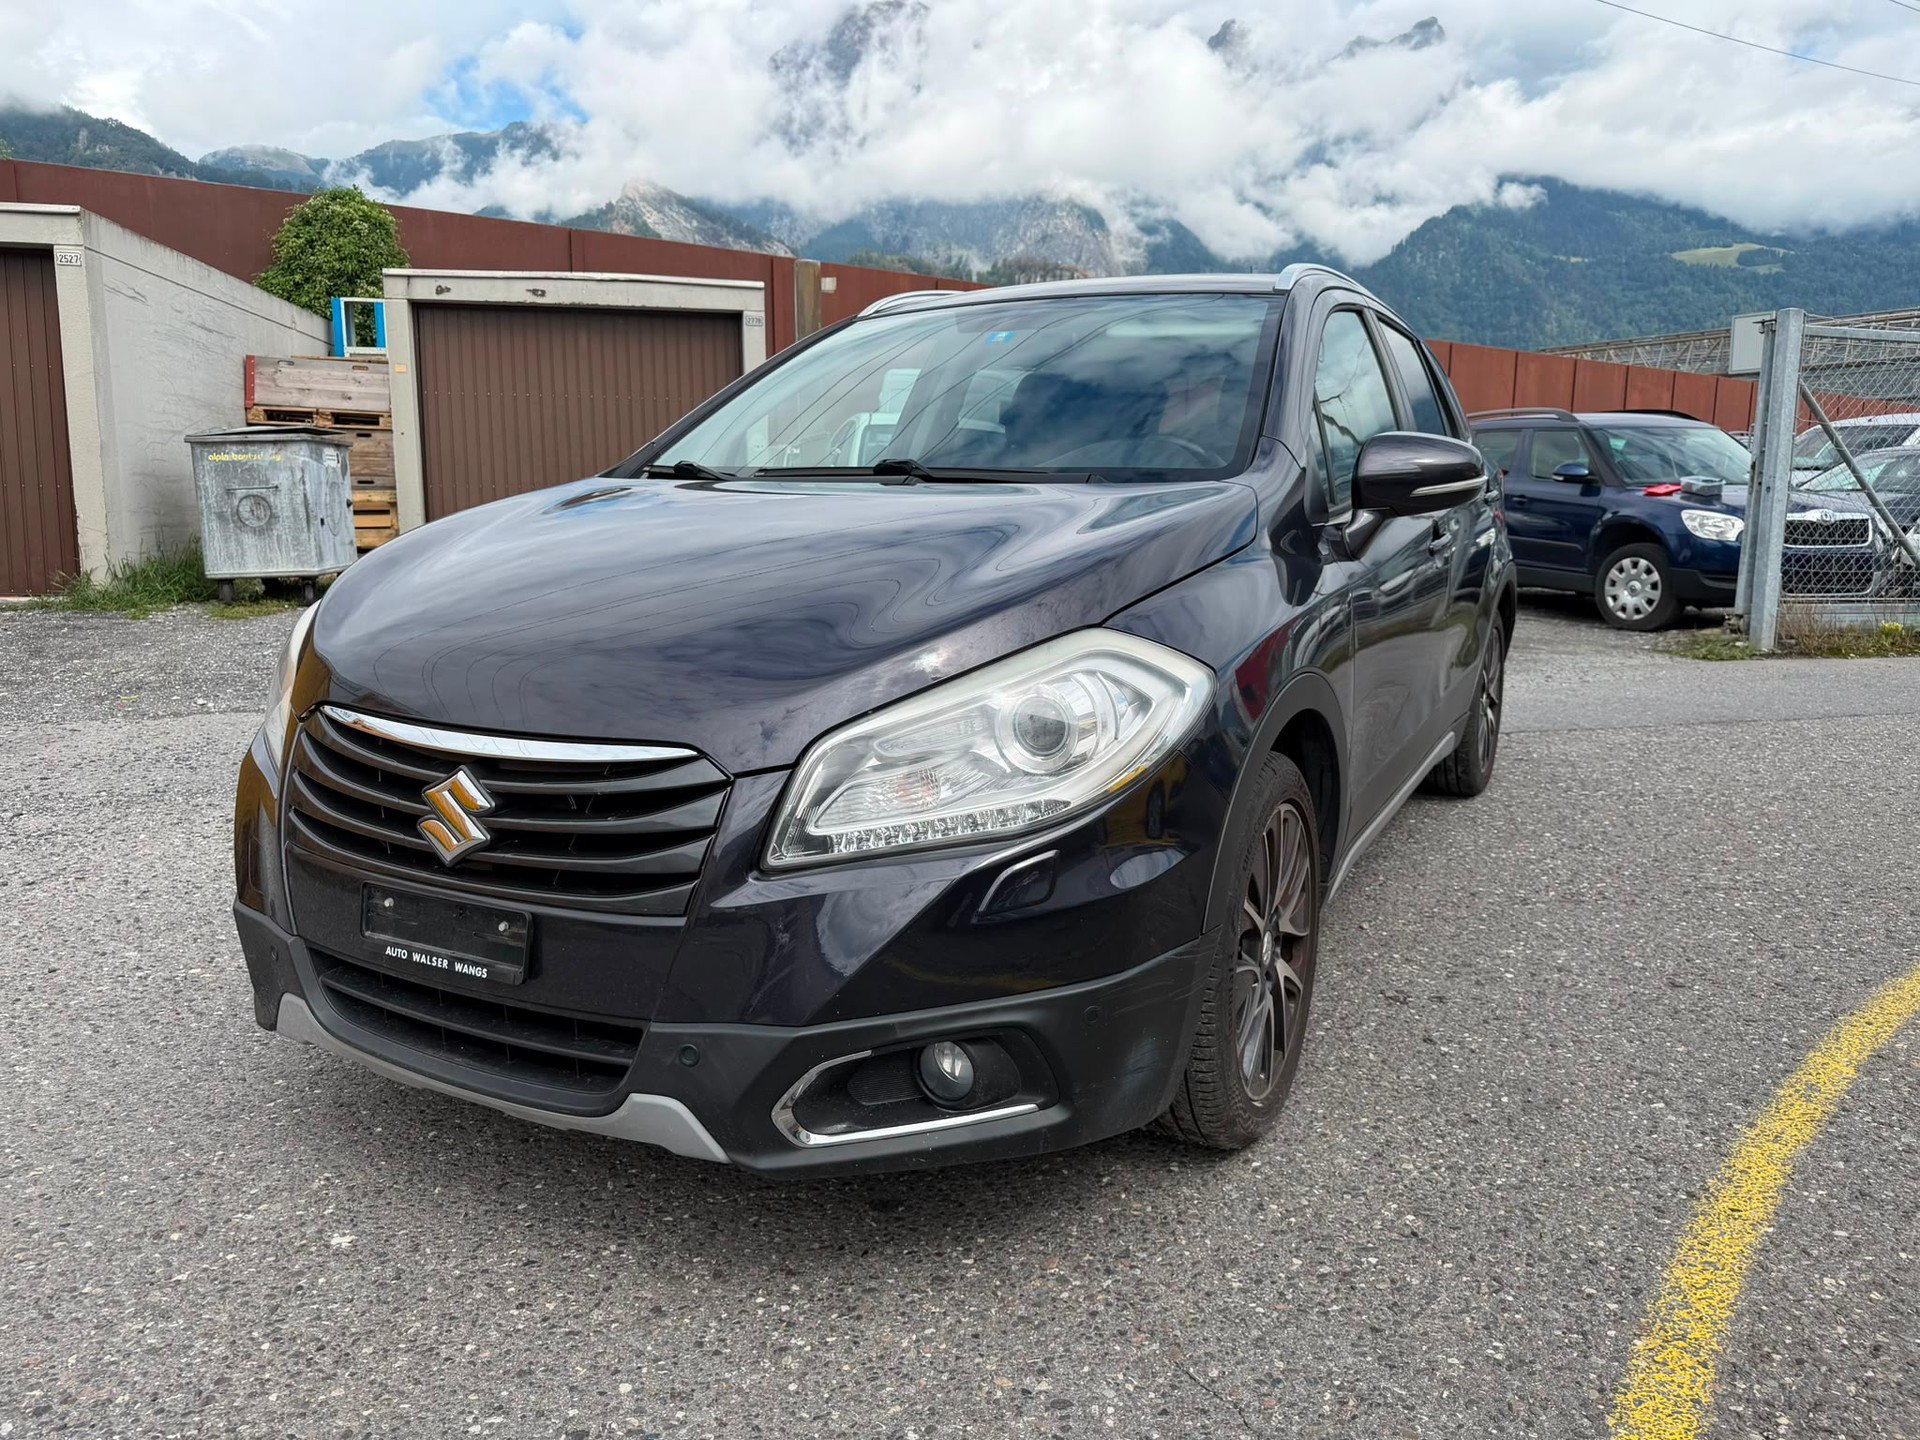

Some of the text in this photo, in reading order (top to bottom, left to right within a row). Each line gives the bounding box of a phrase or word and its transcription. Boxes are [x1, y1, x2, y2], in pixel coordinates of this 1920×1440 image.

[59, 254, 78, 264] 2527
[385, 946, 488, 979] AUTO WALSER WANGS
